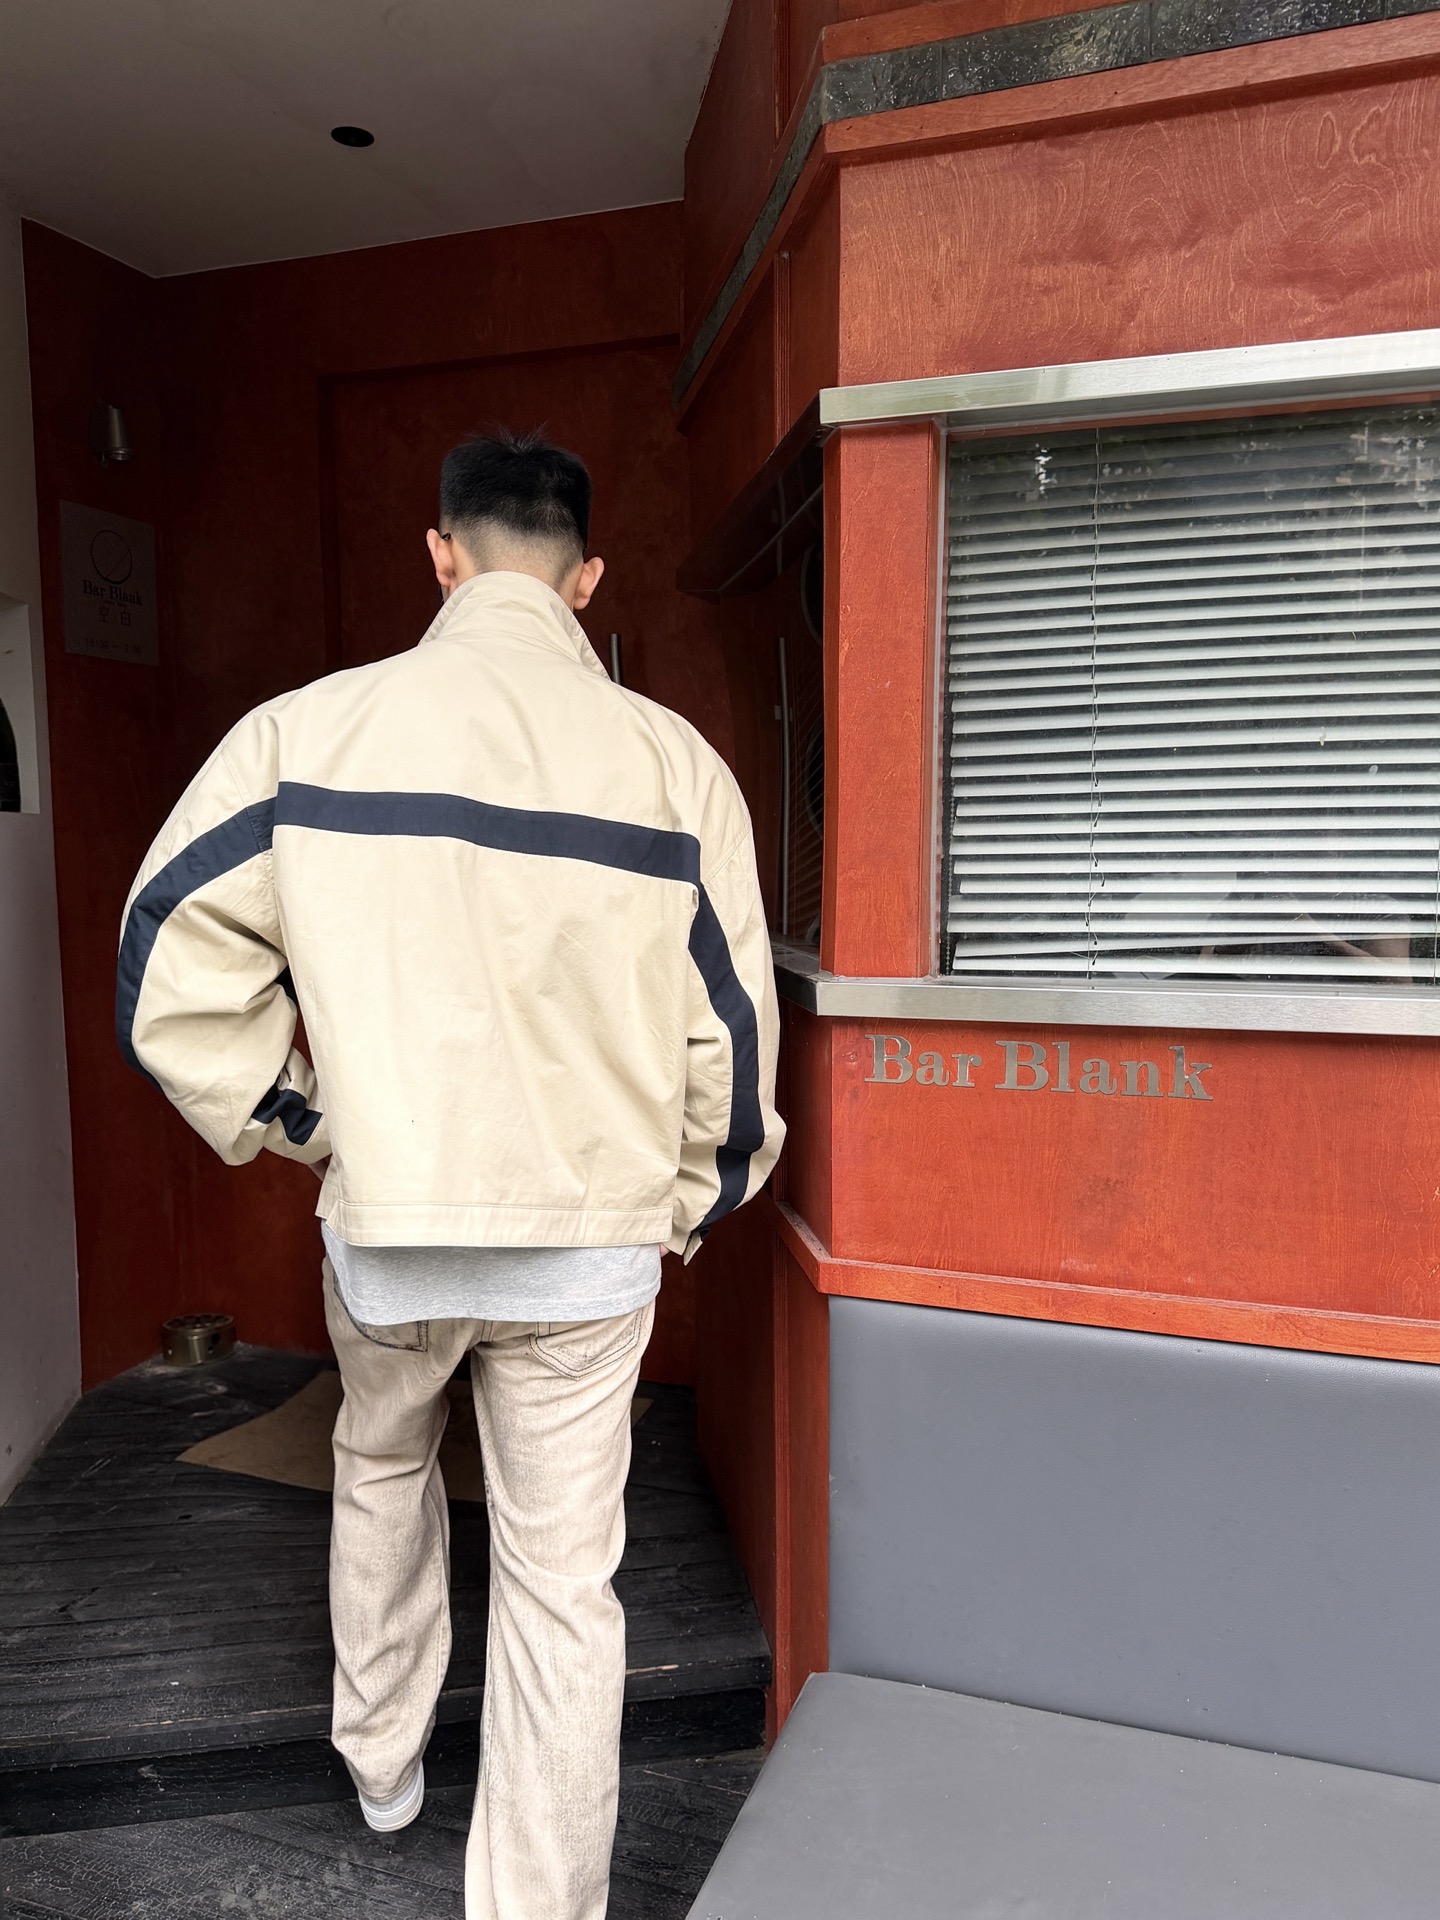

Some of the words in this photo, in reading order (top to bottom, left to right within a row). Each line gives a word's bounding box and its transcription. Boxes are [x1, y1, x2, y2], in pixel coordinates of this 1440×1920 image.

[82, 579, 105, 597] Bar
[108, 585, 143, 606] Blank
[865, 1034, 982, 1087] Bar
[995, 1040, 1213, 1100] Blank
